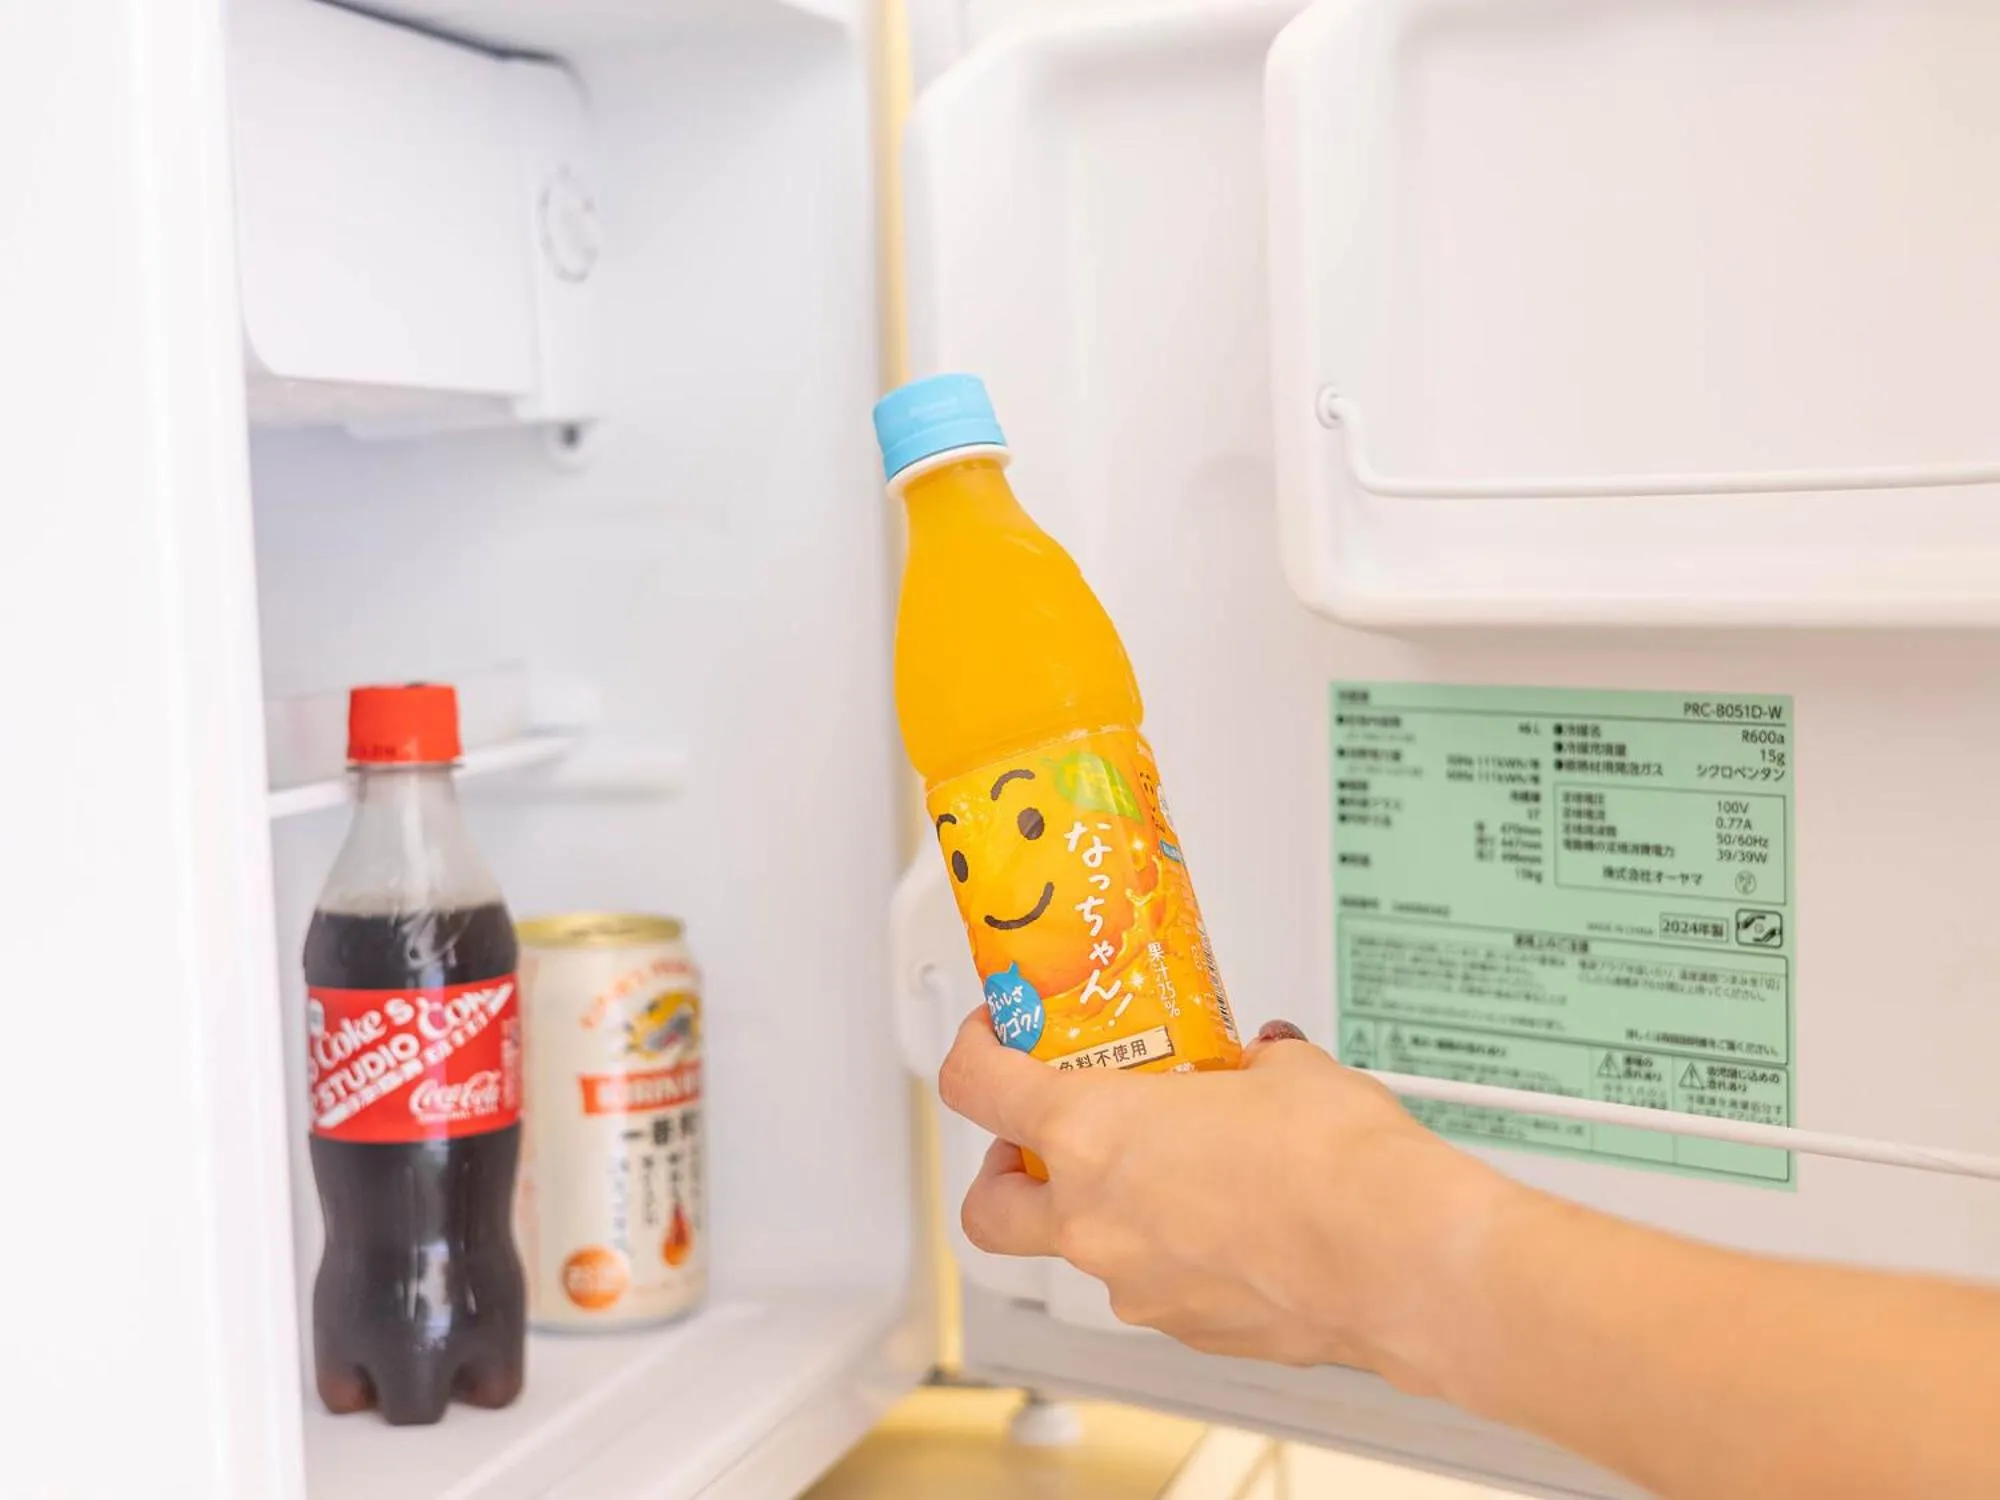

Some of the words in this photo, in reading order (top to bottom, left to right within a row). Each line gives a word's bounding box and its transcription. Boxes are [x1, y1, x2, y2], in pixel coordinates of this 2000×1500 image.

[1684, 702, 1783, 720] PRC-B051D-W
[1741, 730, 1785, 745] R600a
[1760, 749, 1786, 767] 15g
[1696, 764, 1785, 782] シクロペンタン
[1716, 801, 1750, 814] 100V
[1715, 817, 1753, 830] 0.77A
[1715, 834, 1769, 849] 50/60Hz
[1716, 849, 1768, 865] 39/39W
[316, 1033, 420, 1108] STUDIO
